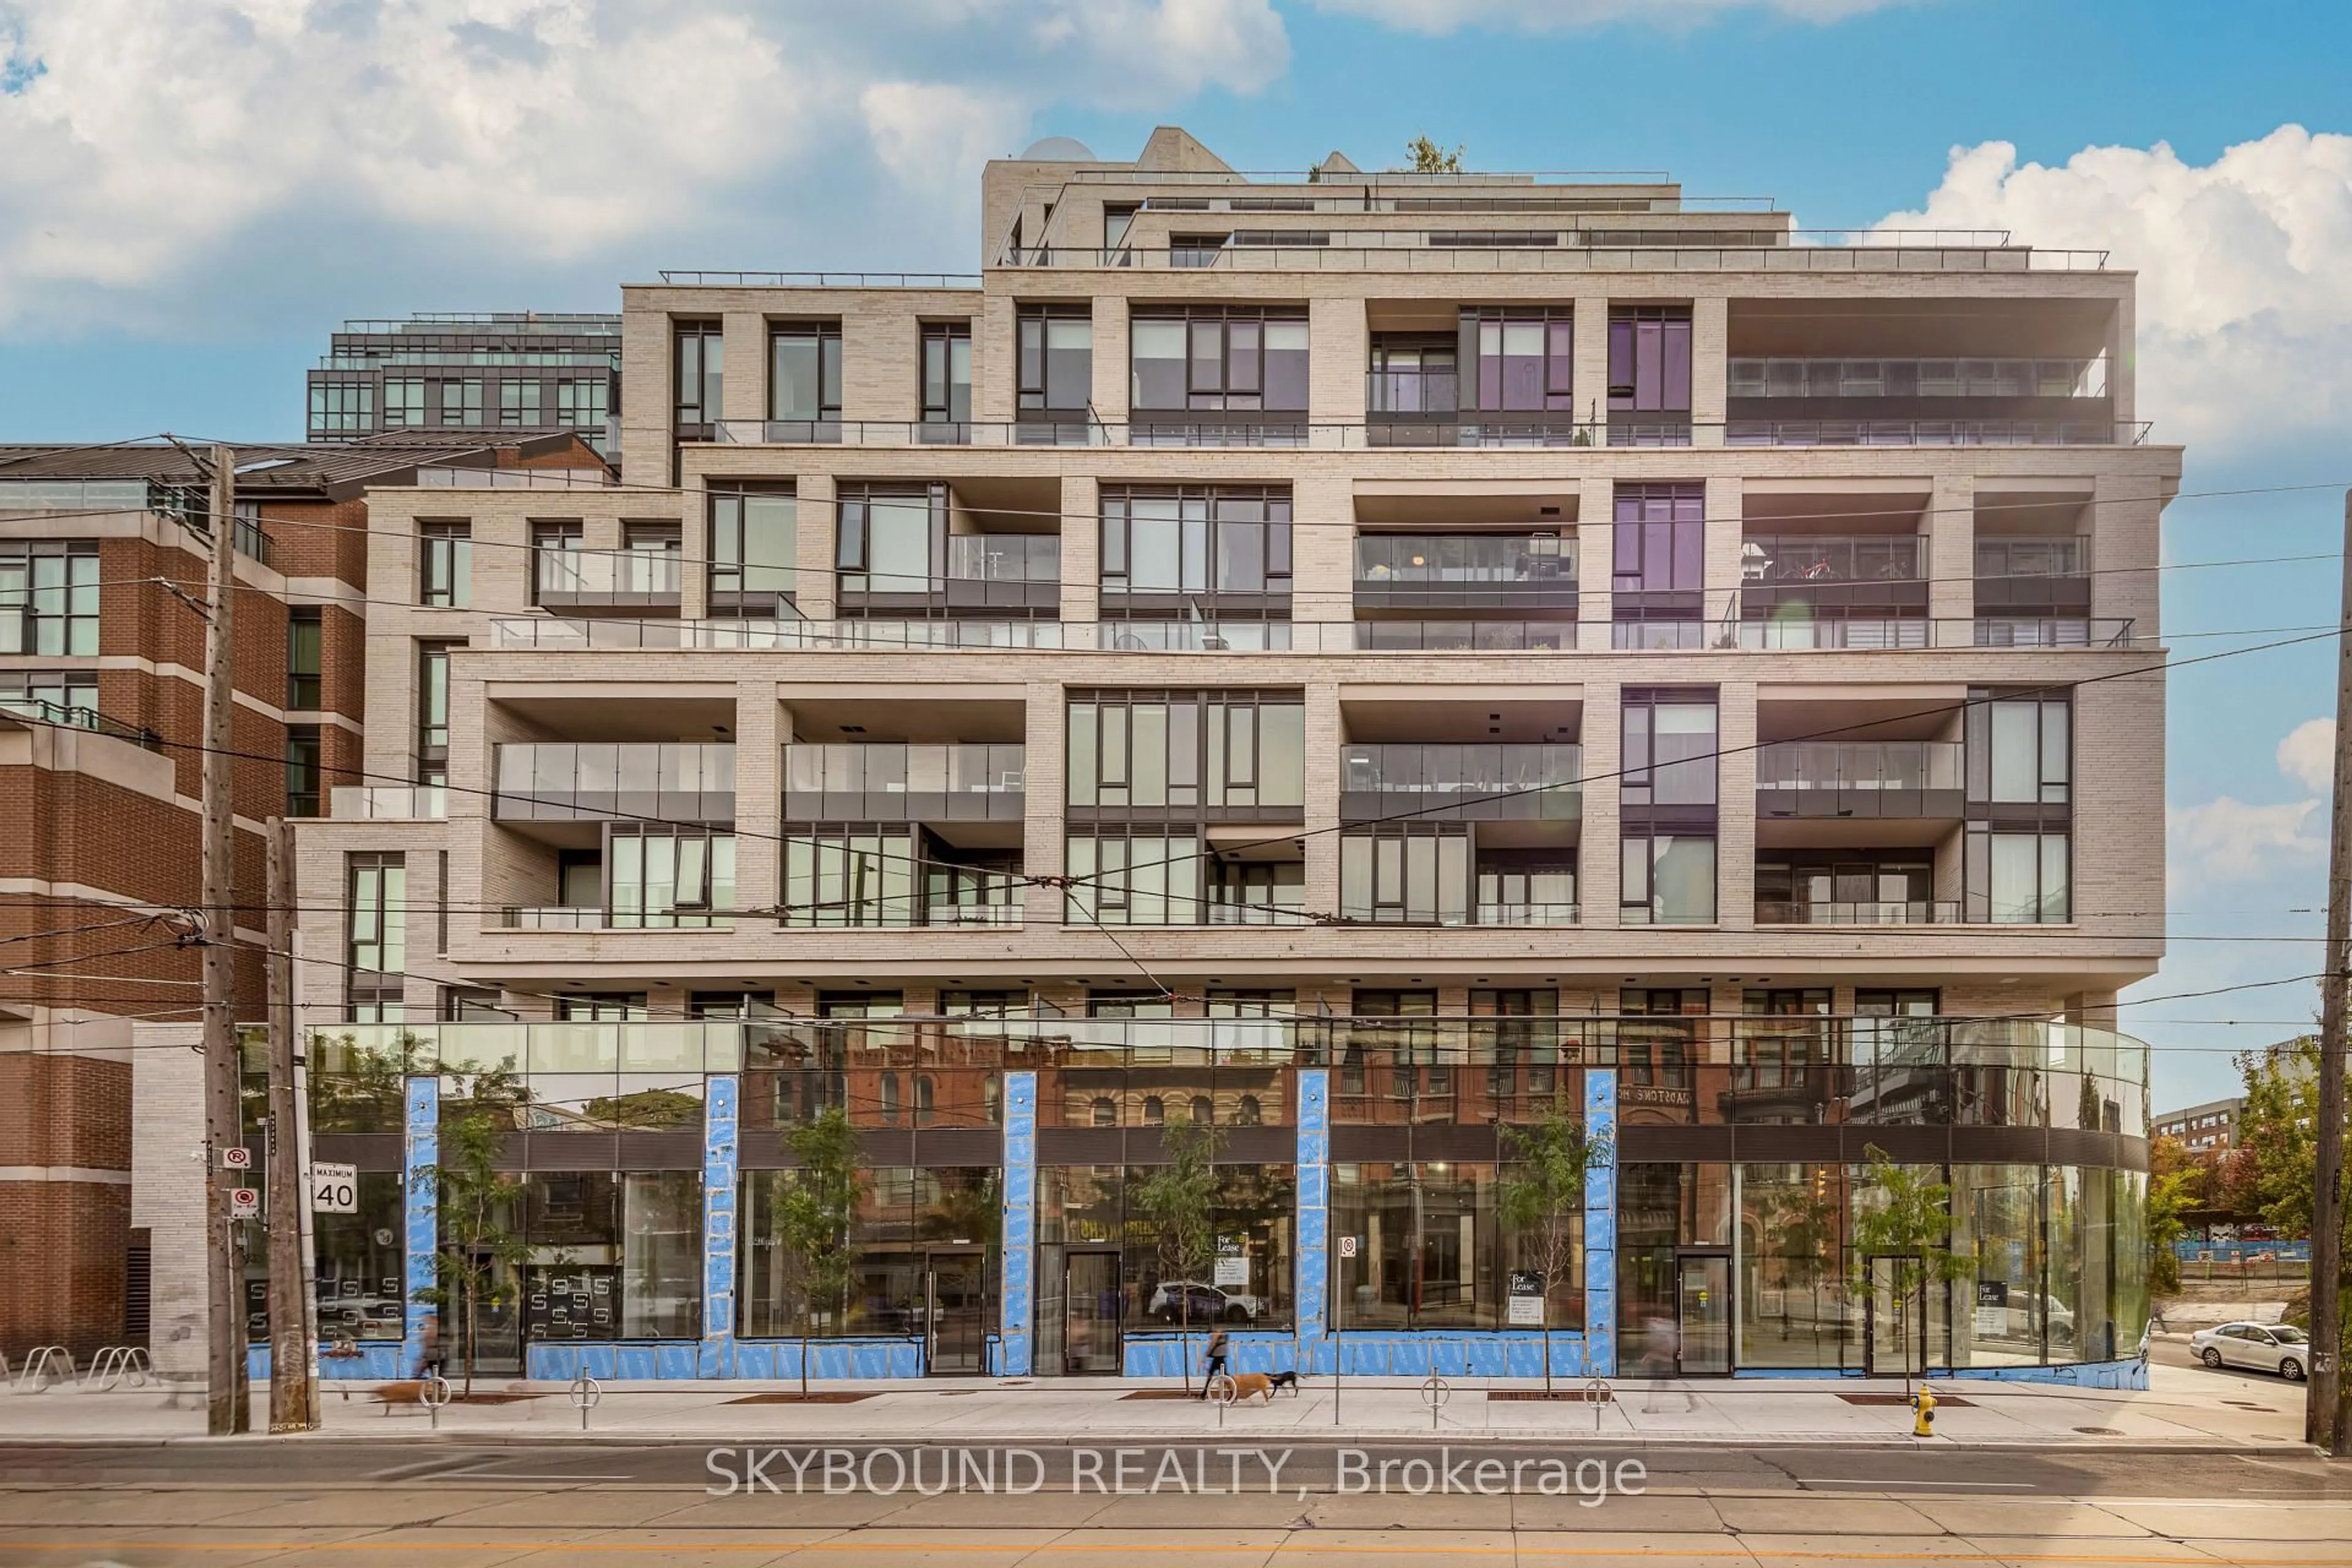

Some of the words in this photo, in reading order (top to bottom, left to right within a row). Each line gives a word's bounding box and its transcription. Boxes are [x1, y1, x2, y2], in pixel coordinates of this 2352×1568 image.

[317, 1169, 353, 1178] MAXIMUM
[316, 1184, 353, 1207] 40
[1218, 1235, 1231, 1244] For
[1218, 1243, 1239, 1252] Lease
[1512, 1274, 1526, 1283] For
[1512, 1283, 1535, 1291] Lease
